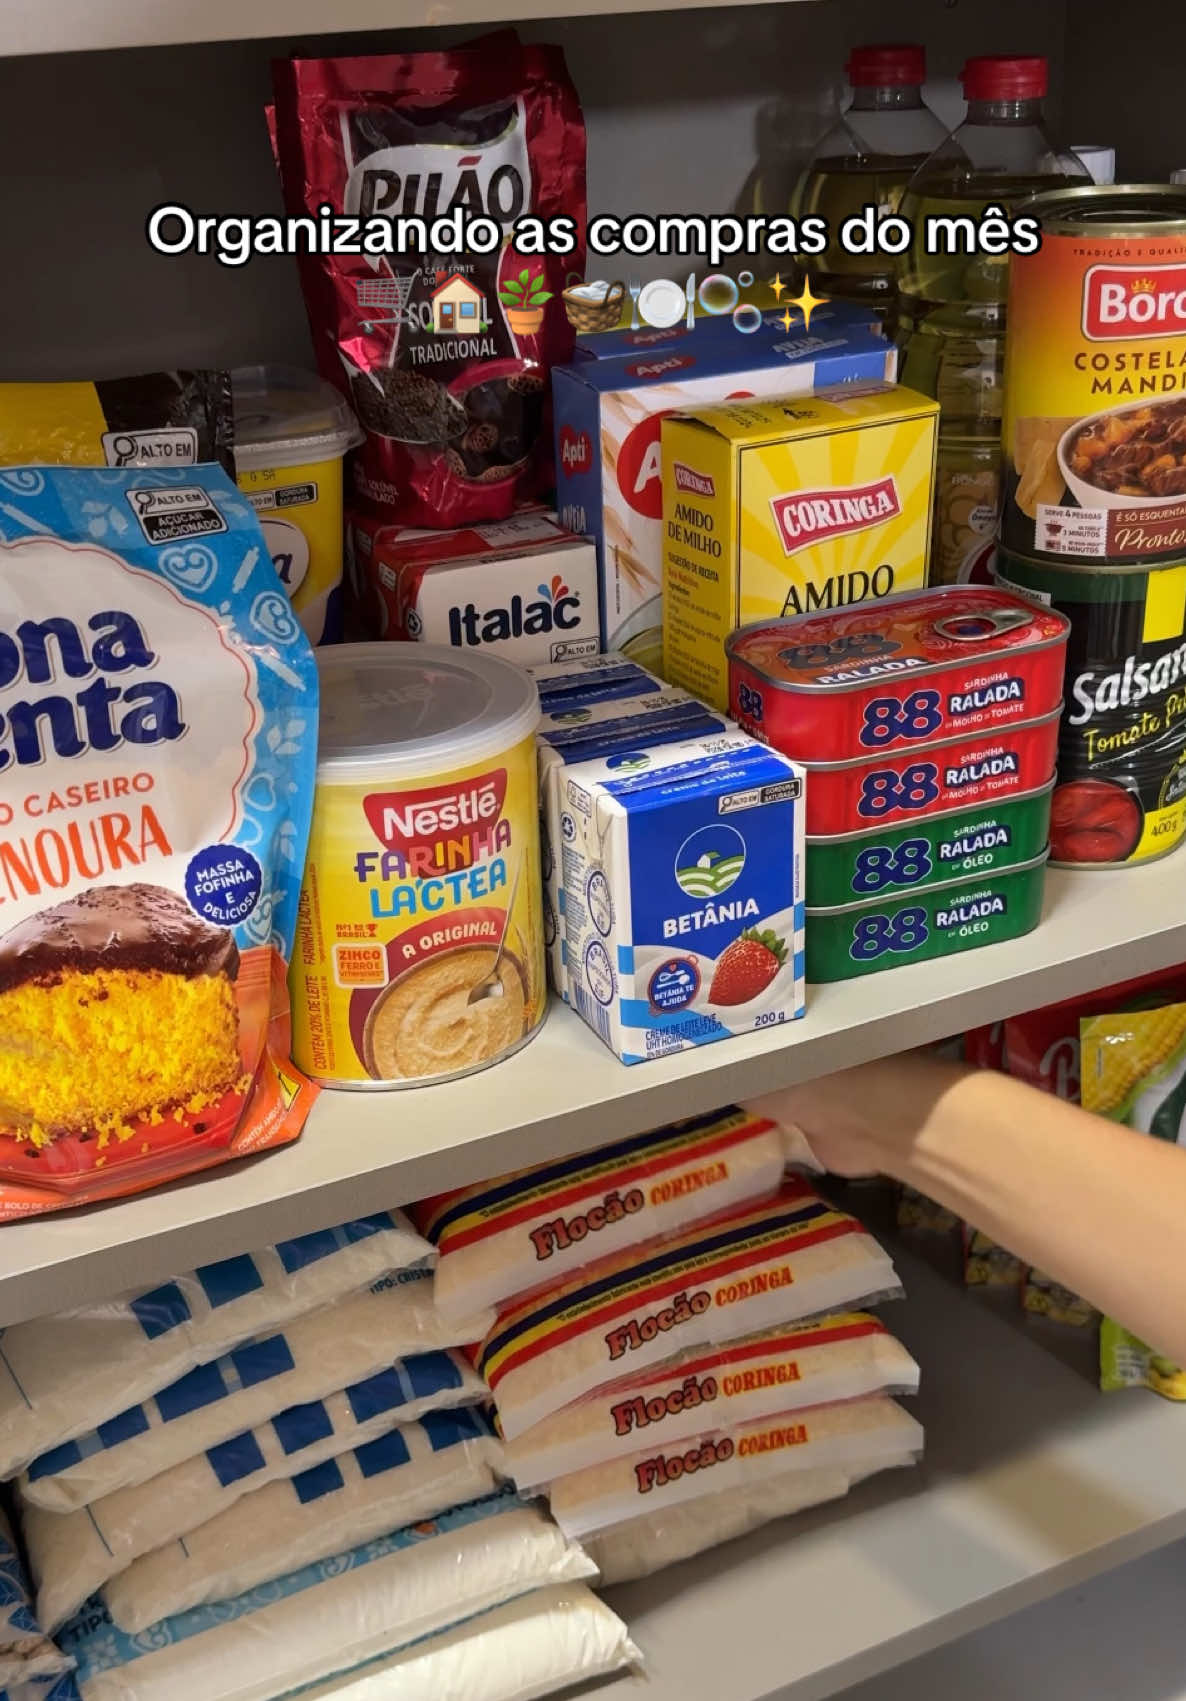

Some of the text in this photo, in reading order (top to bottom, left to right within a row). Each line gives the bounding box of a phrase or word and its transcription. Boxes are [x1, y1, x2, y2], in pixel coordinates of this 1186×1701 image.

[409, 337, 498, 366] TRADICIONAL
[636, 357, 683, 377] Apti
[140, 442, 192, 458] ALTO EM
[562, 437, 586, 468] Apti
[156, 495, 184, 506] ALTO
[782, 491, 895, 537] CORINGA
[1065, 509, 1071, 518] 4
[1071, 511, 1102, 520] PESSOAS
[152, 519, 222, 541] ADICIONADO
[674, 503, 714, 532] AMIDO
[1124, 510, 1138, 522] SÓ
[667, 520, 722, 558] DE MILHO
[779, 563, 895, 618] AMIDO
[448, 594, 581, 647] Italac
[776, 632, 904, 670] 88
[815, 658, 929, 684] RALADA
[963, 672, 1009, 690] SARDINHA
[950, 681, 1021, 713] RALADA
[858, 688, 943, 748] 88
[953, 713, 983, 728] MOLHO
[992, 703, 1025, 718] TOMATE
[1082, 711, 1161, 762] Tomate
[960, 746, 1004, 764] SARDINHA
[946, 755, 1016, 785] RALADA
[23, 772, 155, 817] CASEIRO
[857, 762, 940, 818] 88
[948, 776, 1020, 799] MOLHO TOMATE
[382, 781, 498, 841] Nestlé
[940, 828, 1008, 859] RALADA
[953, 820, 997, 838] SARDINHA
[353, 818, 512, 882] FARINHA
[196, 859, 245, 882] MASSA
[851, 837, 933, 893] 88
[194, 869, 255, 897] FOFINHA
[225, 891, 236, 904] E
[370, 857, 508, 919] LÁCTEA
[202, 891, 257, 921] DELICIOSA
[936, 897, 1004, 927] RALADA
[949, 889, 993, 907] SARDINHA
[663, 899, 760, 939] BETÂNIA
[401, 921, 498, 960] A ORIGINAL
[849, 906, 930, 962] 88
[339, 950, 381, 961] ZINCO
[340, 961, 374, 970] FERRO
[305, 975, 320, 998] LEITE
[661, 995, 687, 1007] AJUDA
[307, 998, 322, 1011] DE
[645, 1027, 671, 1041] CREME
[681, 1020, 701, 1033] LEITE
[701, 1013, 718, 1026] LEVE
[754, 1012, 776, 1027] 200
[645, 1037, 660, 1051] UHT
[529, 1188, 645, 1260] Flocão
[649, 1161, 729, 1206] CORINGA
[605, 1290, 712, 1360] Flocão
[714, 1266, 795, 1307] CORINGA
[610, 1361, 801, 1437] Flocão CORINGA
[634, 1424, 809, 1494] Flocão CORINGA
